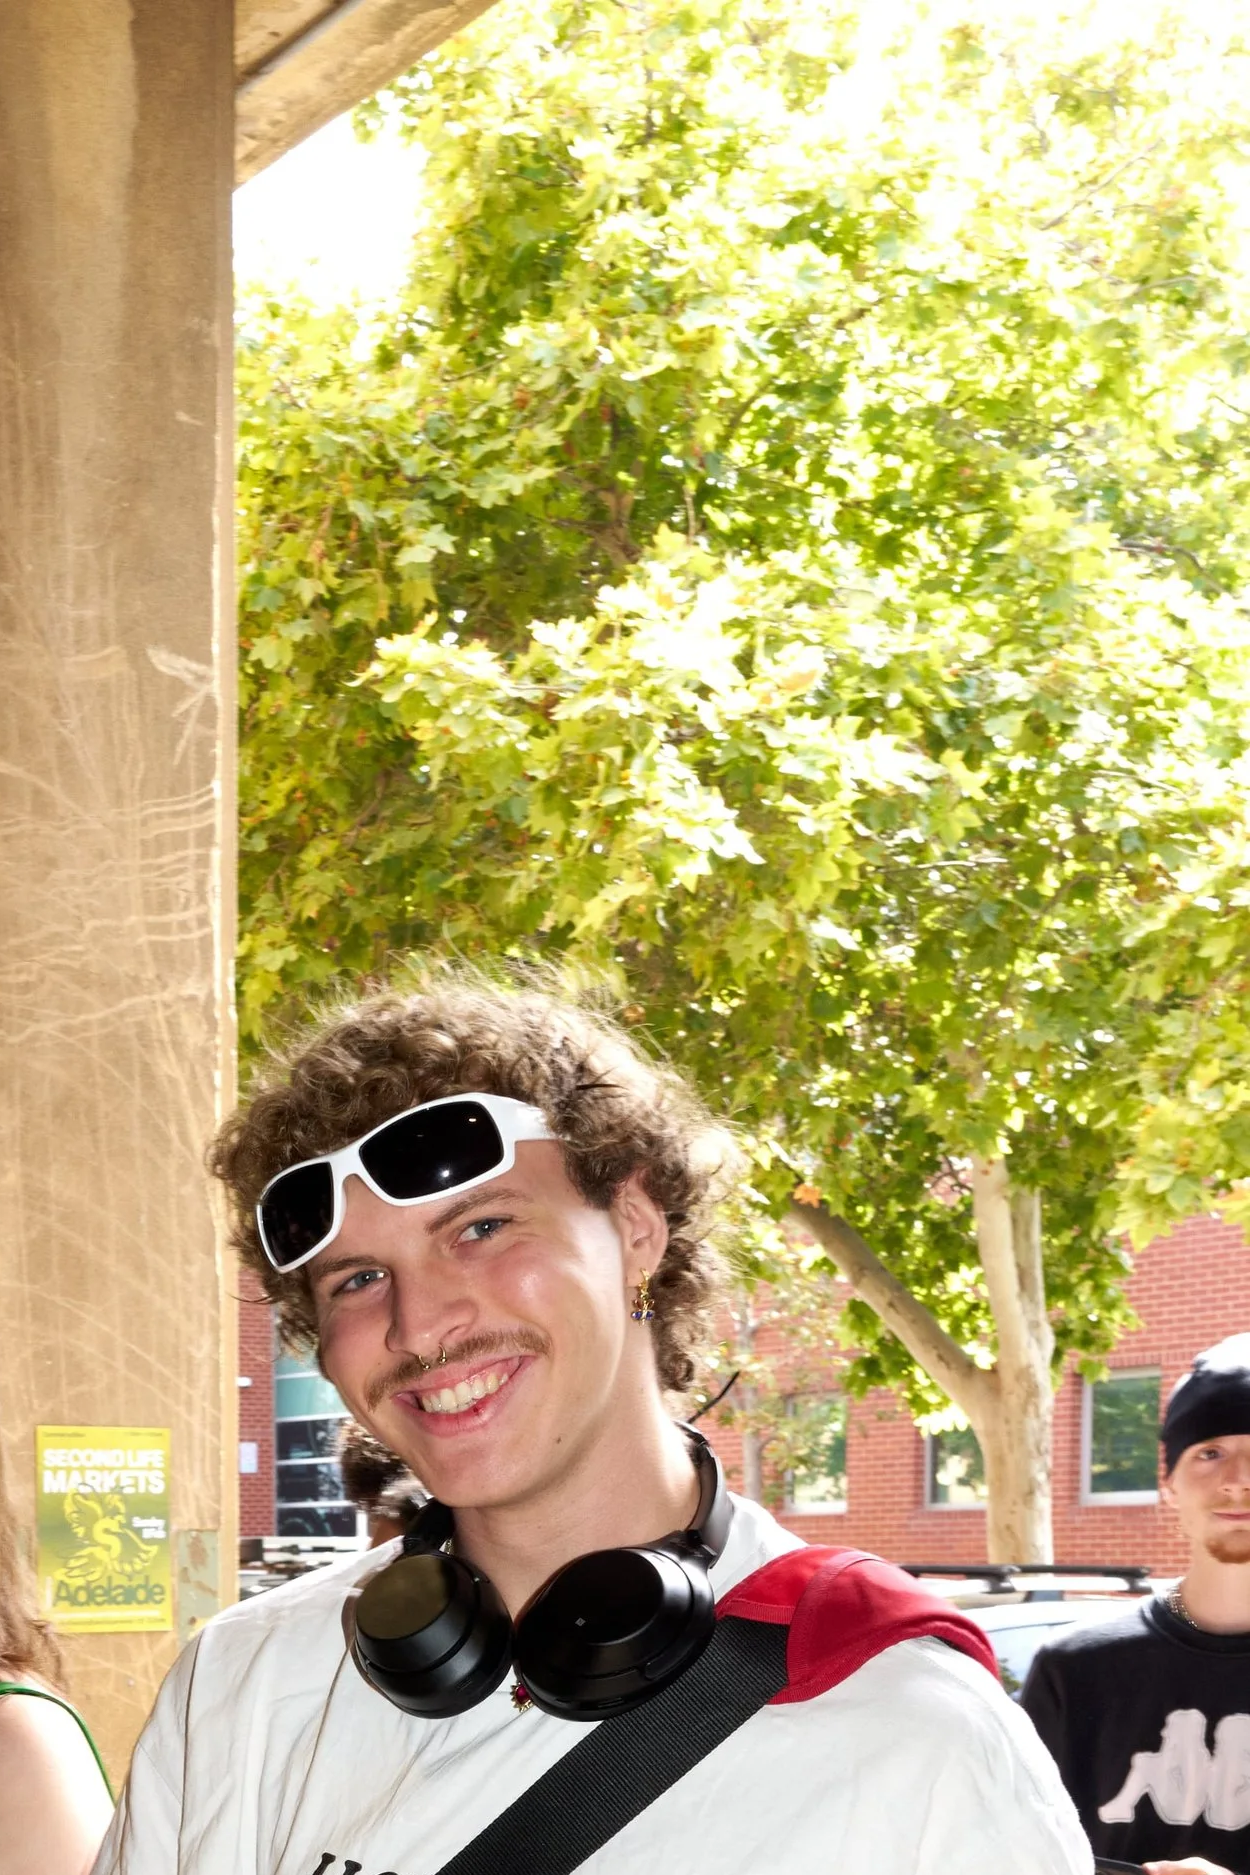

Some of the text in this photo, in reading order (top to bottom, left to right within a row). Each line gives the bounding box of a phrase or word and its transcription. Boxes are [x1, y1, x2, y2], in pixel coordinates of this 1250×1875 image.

[42, 1448, 165, 1468] SECOND LIFE
[42, 1469, 166, 1494] MARKETS
[53, 1575, 165, 1606] Adelaide
